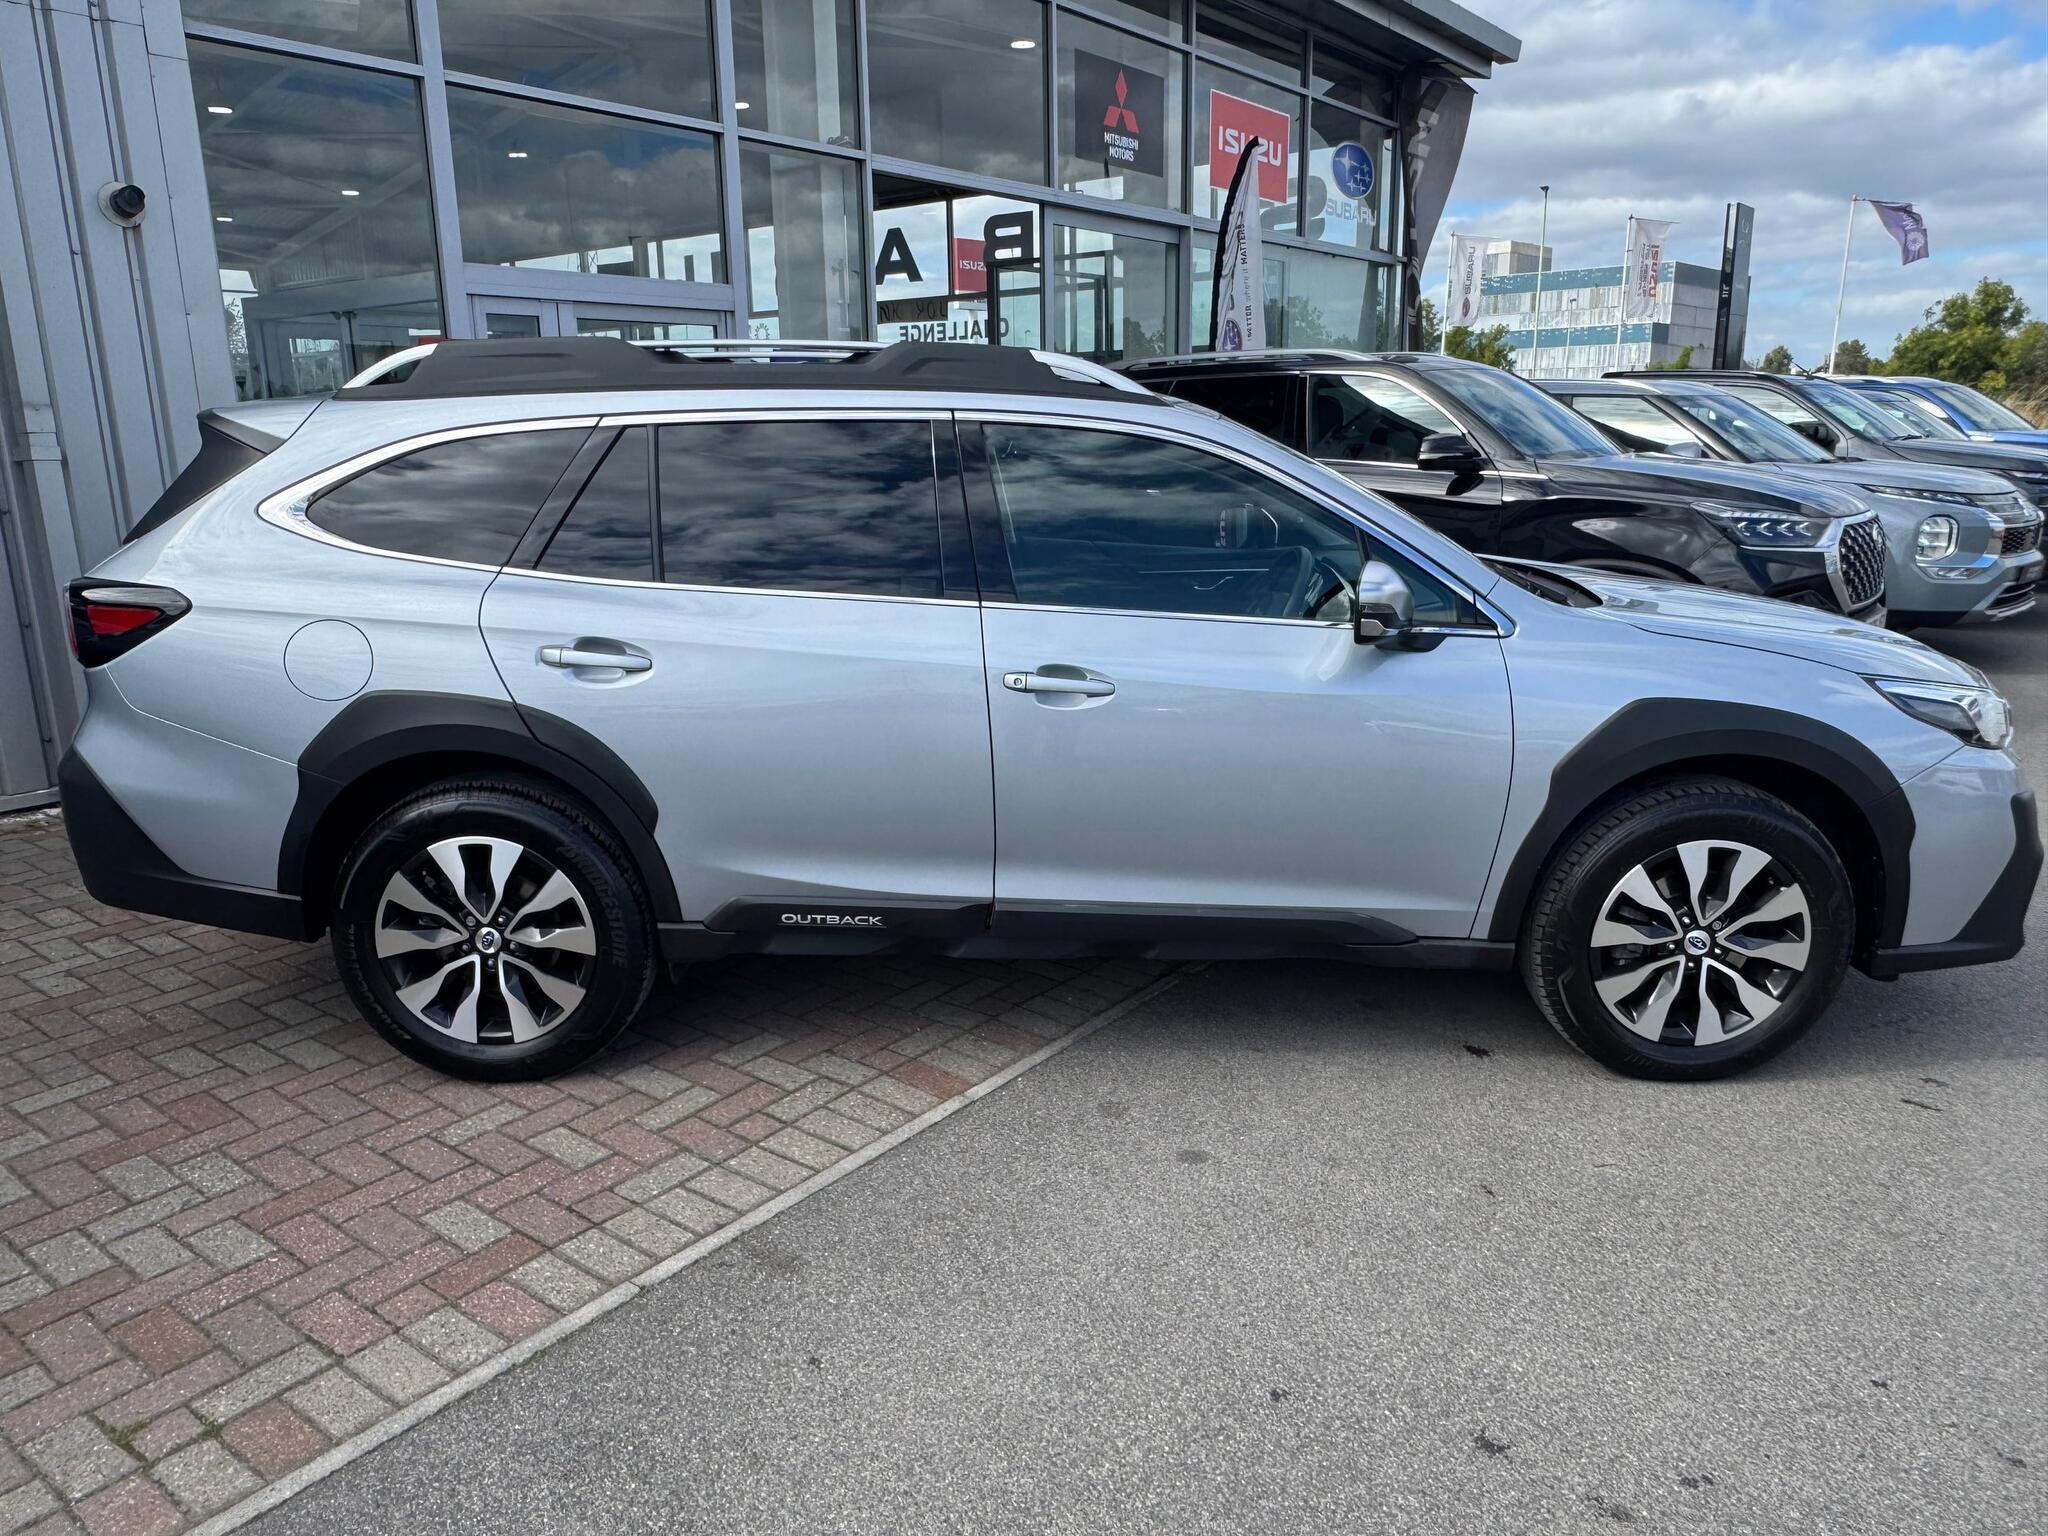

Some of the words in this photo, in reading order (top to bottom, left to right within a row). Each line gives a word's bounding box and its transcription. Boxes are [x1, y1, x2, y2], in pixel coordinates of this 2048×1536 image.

[1104, 132, 1139, 151] MITSUBISHI
[1109, 146, 1135, 162] MOTORS
[1325, 198, 1377, 227] SUBARU
[959, 259, 987, 272] ISUZ
[1464, 246, 1476, 295] SUBARU
[780, 913, 883, 926] OUTBACK
